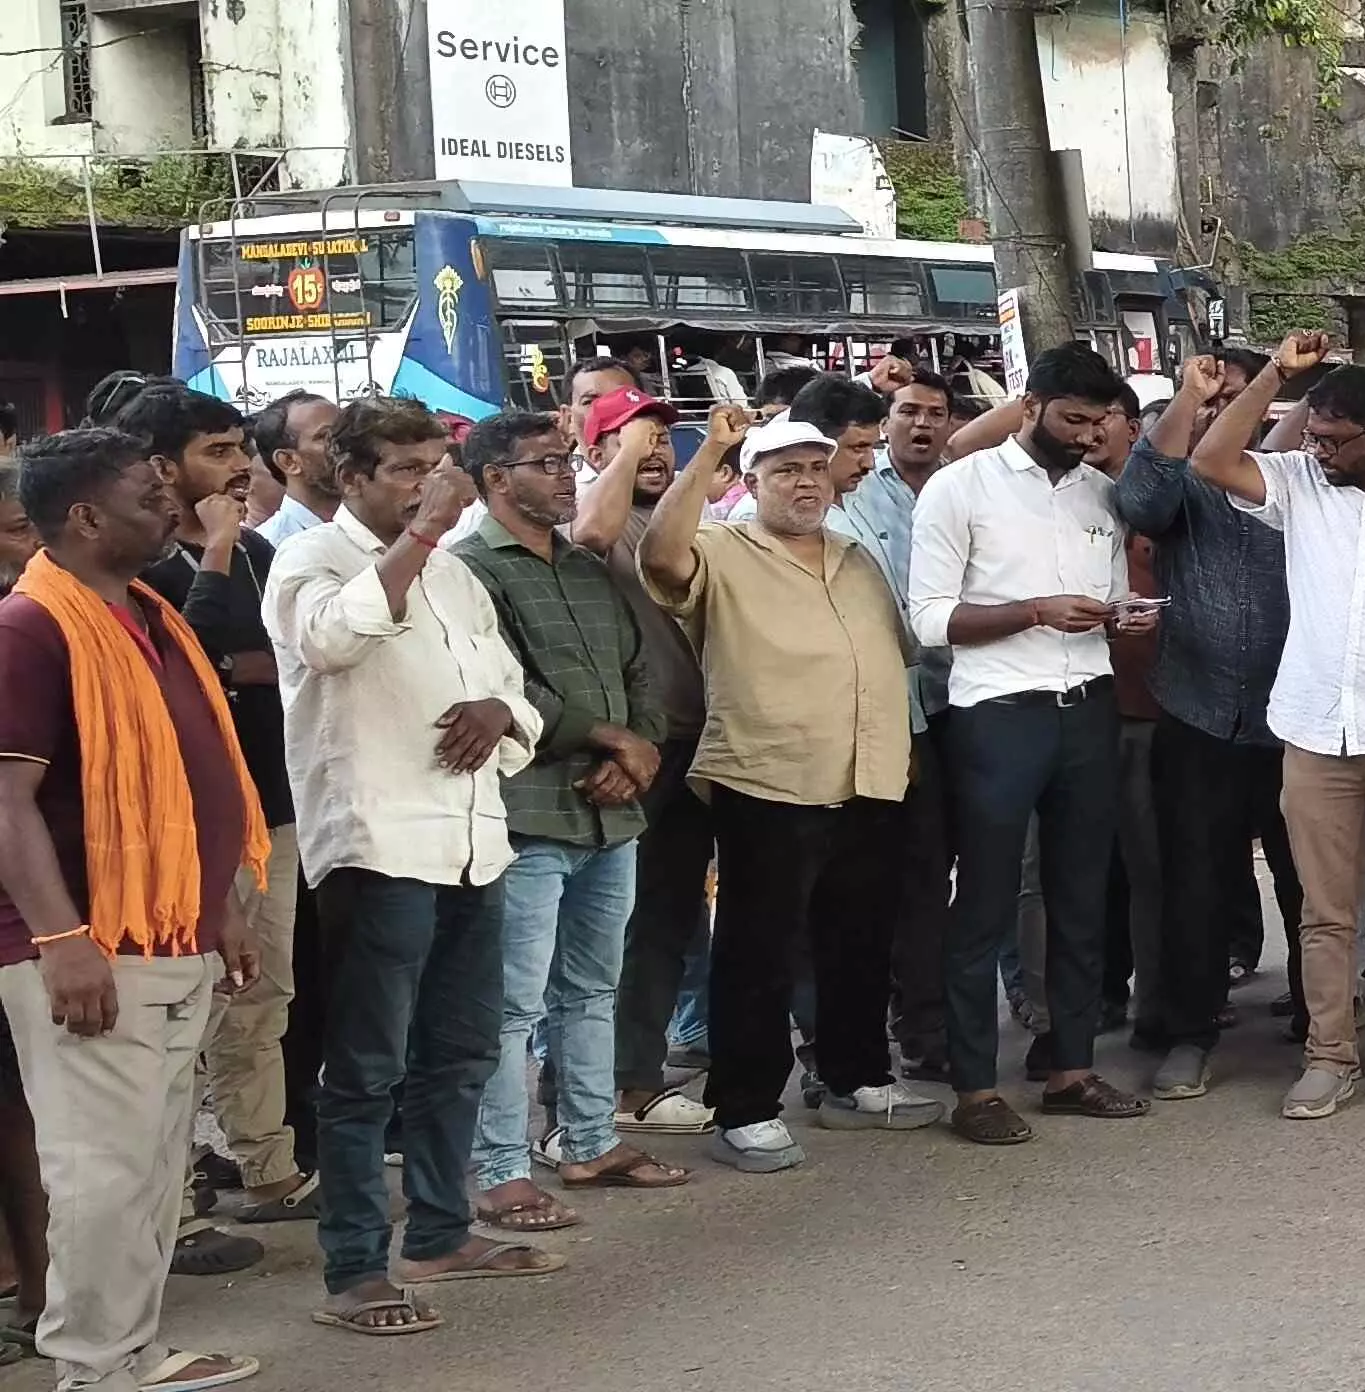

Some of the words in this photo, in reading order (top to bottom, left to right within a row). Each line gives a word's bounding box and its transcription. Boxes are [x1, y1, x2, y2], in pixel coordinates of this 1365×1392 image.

[436, 30, 559, 68] Service
[441, 137, 491, 158] IDEAL
[497, 141, 565, 163] DIESELS
